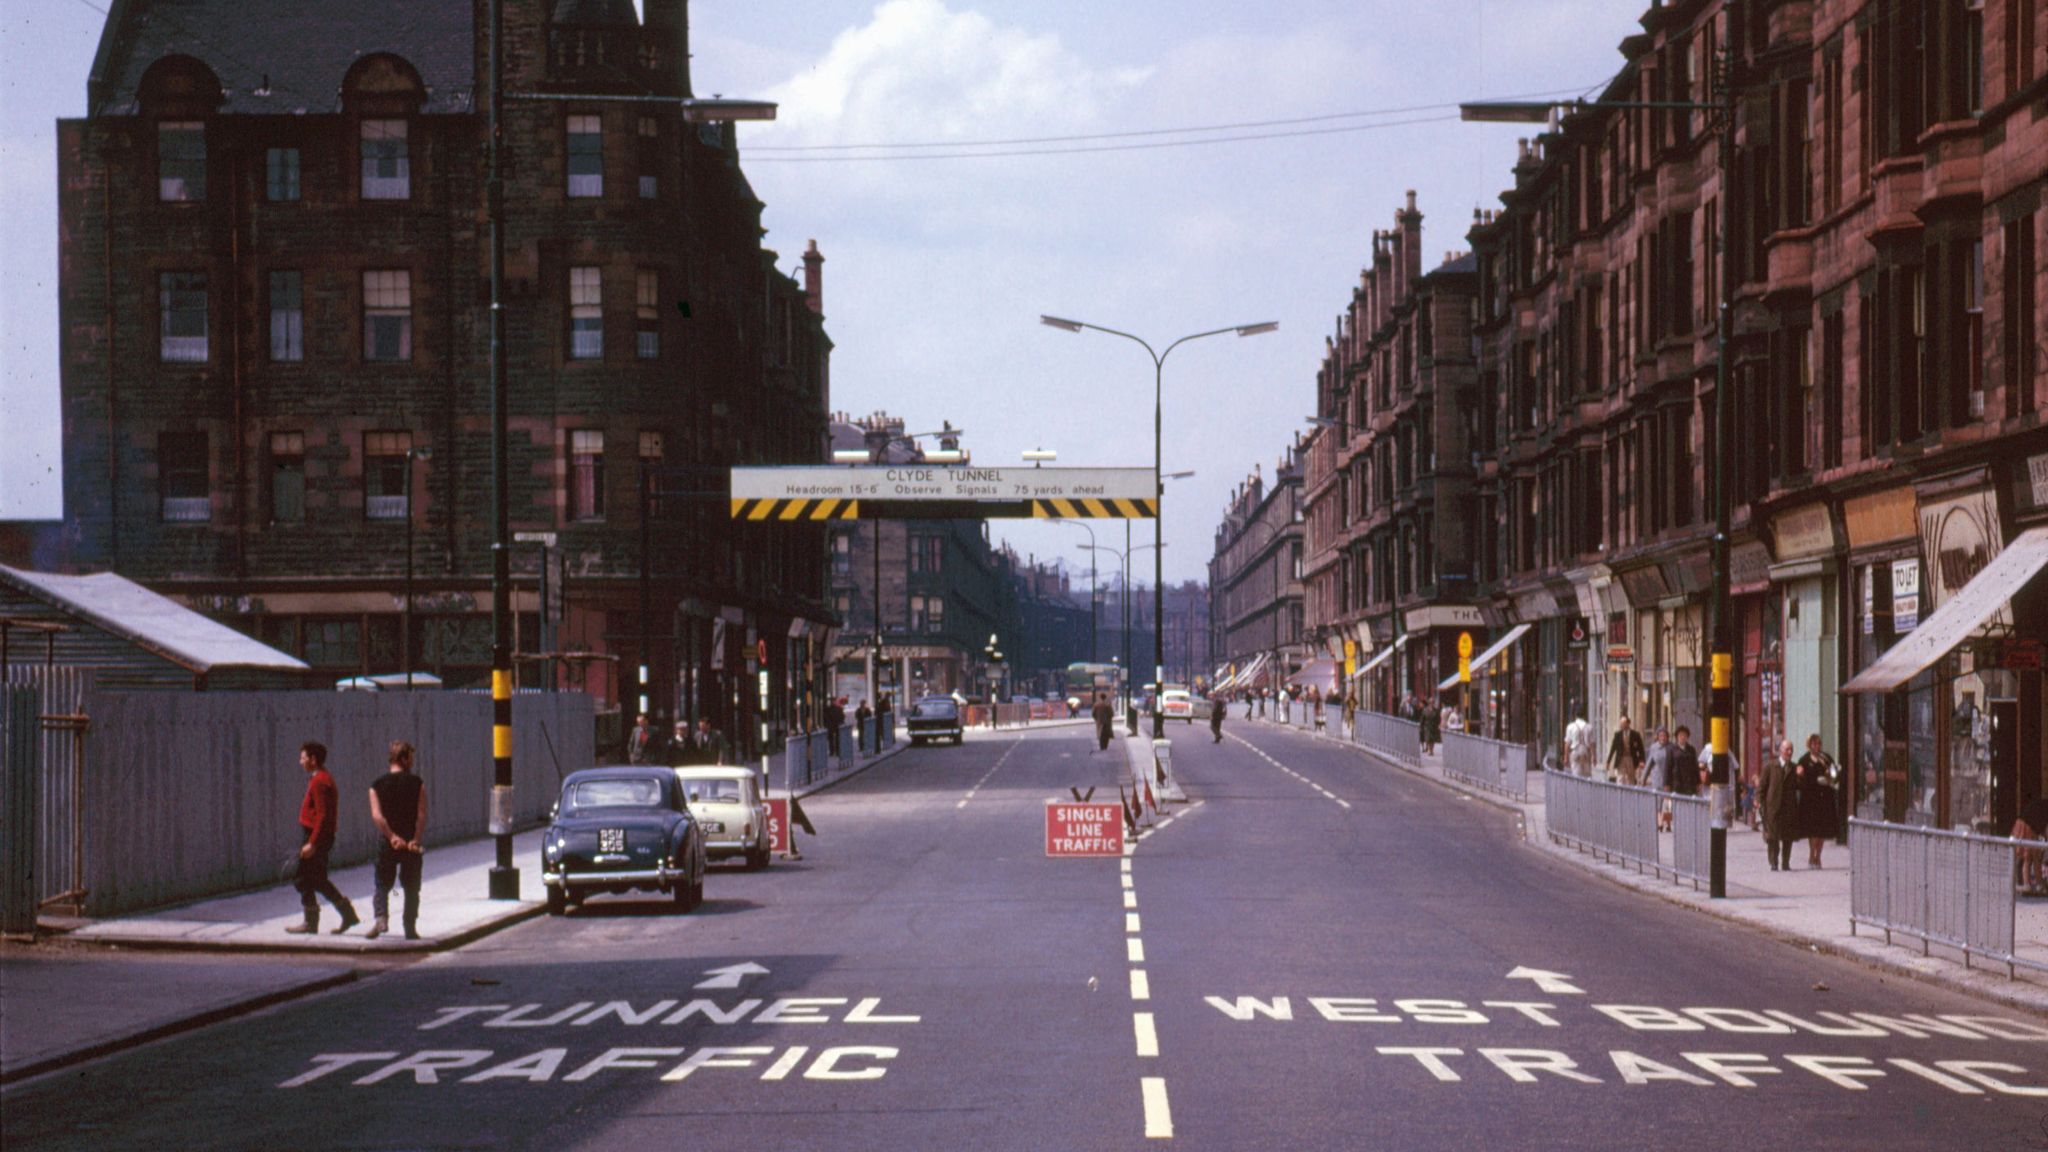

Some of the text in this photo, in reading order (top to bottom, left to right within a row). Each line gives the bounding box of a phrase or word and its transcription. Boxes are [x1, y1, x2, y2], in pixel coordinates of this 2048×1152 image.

[886, 469, 1003, 482] CLYDE TUNNEL
[786, 485, 843, 495] Headroom
[894, 485, 942, 495] Observe
[956, 485, 998, 497] Signals
[1015, 484, 1029, 495] 75
[1033, 485, 1063, 497] yards
[1072, 485, 1105, 495] ahead
[1895, 566, 1917, 587] TO LET
[1453, 609, 1483, 621] THE
[1056, 807, 1113, 822] SINGLE
[1066, 823, 1103, 837] LINE
[1053, 838, 1117, 852] TRAFFIC
[418, 997, 922, 1030] TUNNEL
[1203, 996, 2048, 1041] WEST BOUND
[277, 1045, 900, 1088] TRAFFIC
[1375, 1047, 2048, 1096] TRAFFIC
